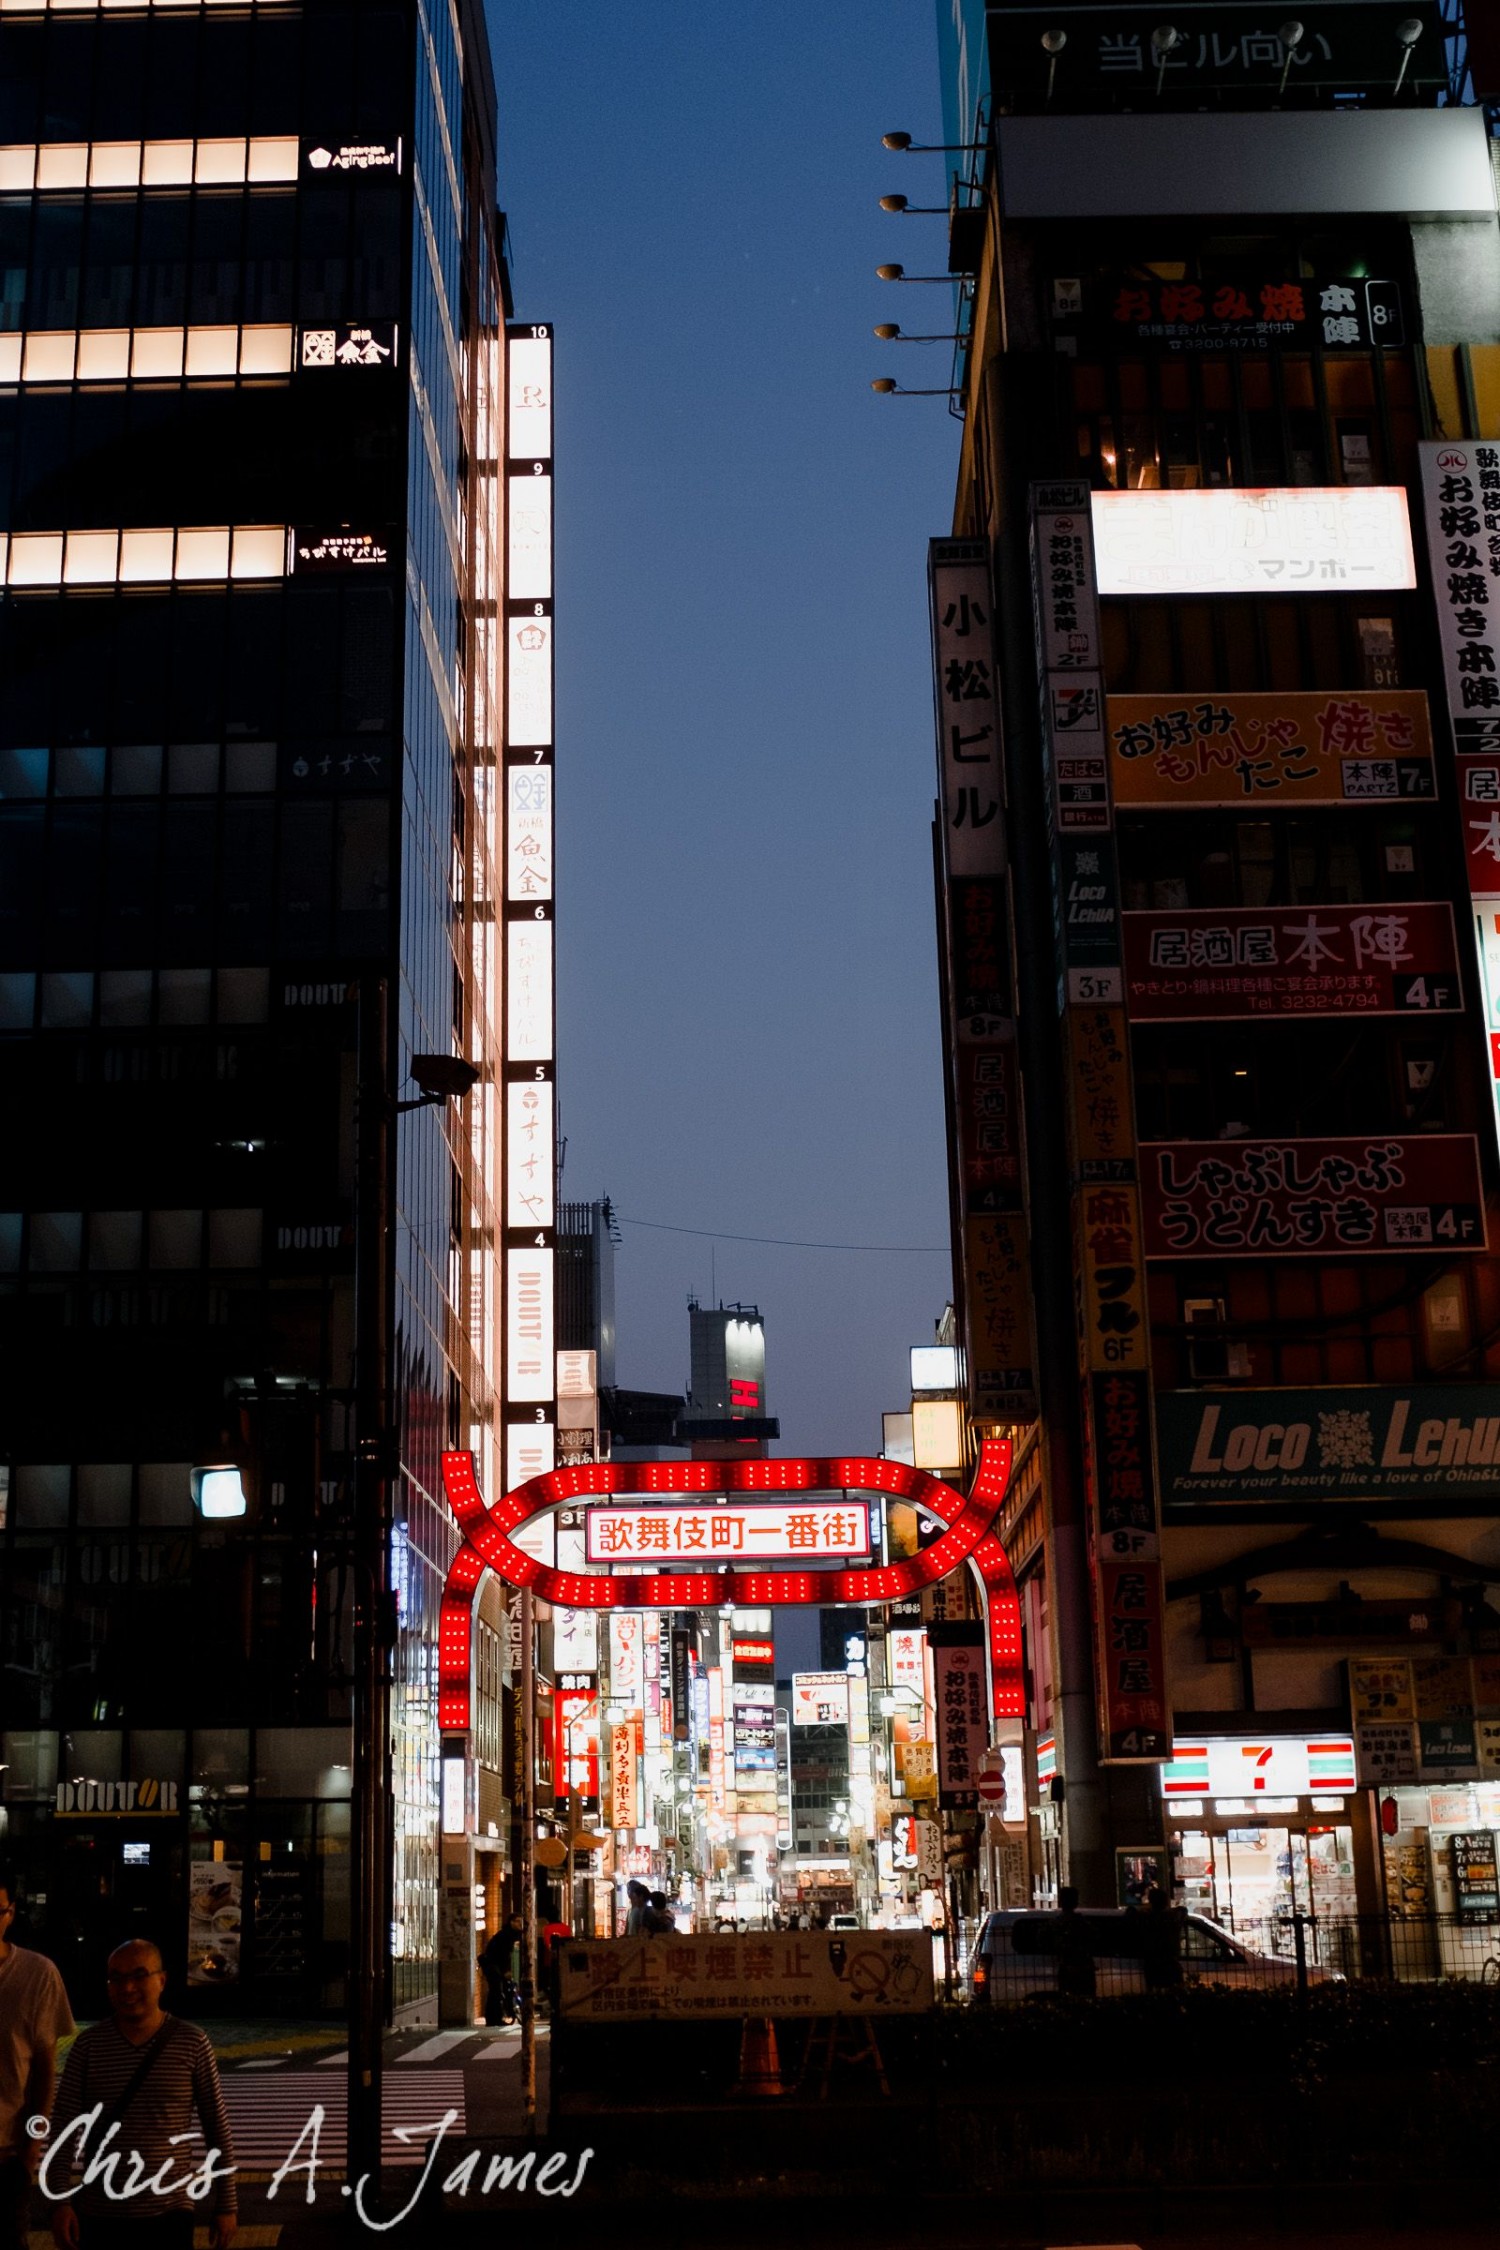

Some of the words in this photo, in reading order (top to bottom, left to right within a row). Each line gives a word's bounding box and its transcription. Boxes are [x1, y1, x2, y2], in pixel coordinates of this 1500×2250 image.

[1112, 283, 1307, 322] お好み焼
[1372, 304, 1398, 327] 8F
[532, 327, 546, 338] 10
[534, 464, 543, 475] 9
[1258, 558, 1375, 579] マンボー
[535, 604, 543, 616] 8
[1057, 654, 1090, 666] 2F
[942, 595, 998, 829] 小松ビル
[1113, 702, 1235, 760] お好み
[1315, 697, 1418, 757] 焼き
[535, 751, 543, 763] 7
[1153, 716, 1300, 784] もんじゃ
[1059, 761, 1104, 777] たばこ
[1235, 745, 1321, 795] たこ
[1346, 762, 1397, 782] 本陣
[1400, 766, 1432, 793] 7F
[1072, 785, 1094, 801] 酒
[515, 834, 547, 894] 魚金
[536, 907, 544, 919] 6
[1150, 925, 1280, 969] 居酒屋
[1282, 913, 1415, 973] 本陣
[1079, 977, 1112, 998] 3F
[1405, 976, 1450, 1010] 4F
[536, 1068, 545, 1081] 5
[1157, 1141, 1405, 1198] しゃぶしゃぶ
[1159, 1196, 1378, 1248] うどんすき
[1435, 1209, 1476, 1240] 4F
[535, 1234, 544, 1247] 4
[1103, 1337, 1133, 1362] 6F
[536, 1409, 545, 1424] 3
[1189, 1404, 1313, 1474] Loco
[1280, 1474, 1336, 1487] beauty
[1387, 1472, 1419, 1482] love
[598, 1512, 858, 1551] 歌舞伎町一番街
[1111, 1531, 1147, 1554] 8F
[1121, 1730, 1157, 1753] 4F
[57, 1778, 178, 1812] DOUTOR
[591, 1942, 813, 1987] 路上喫煙禁止
